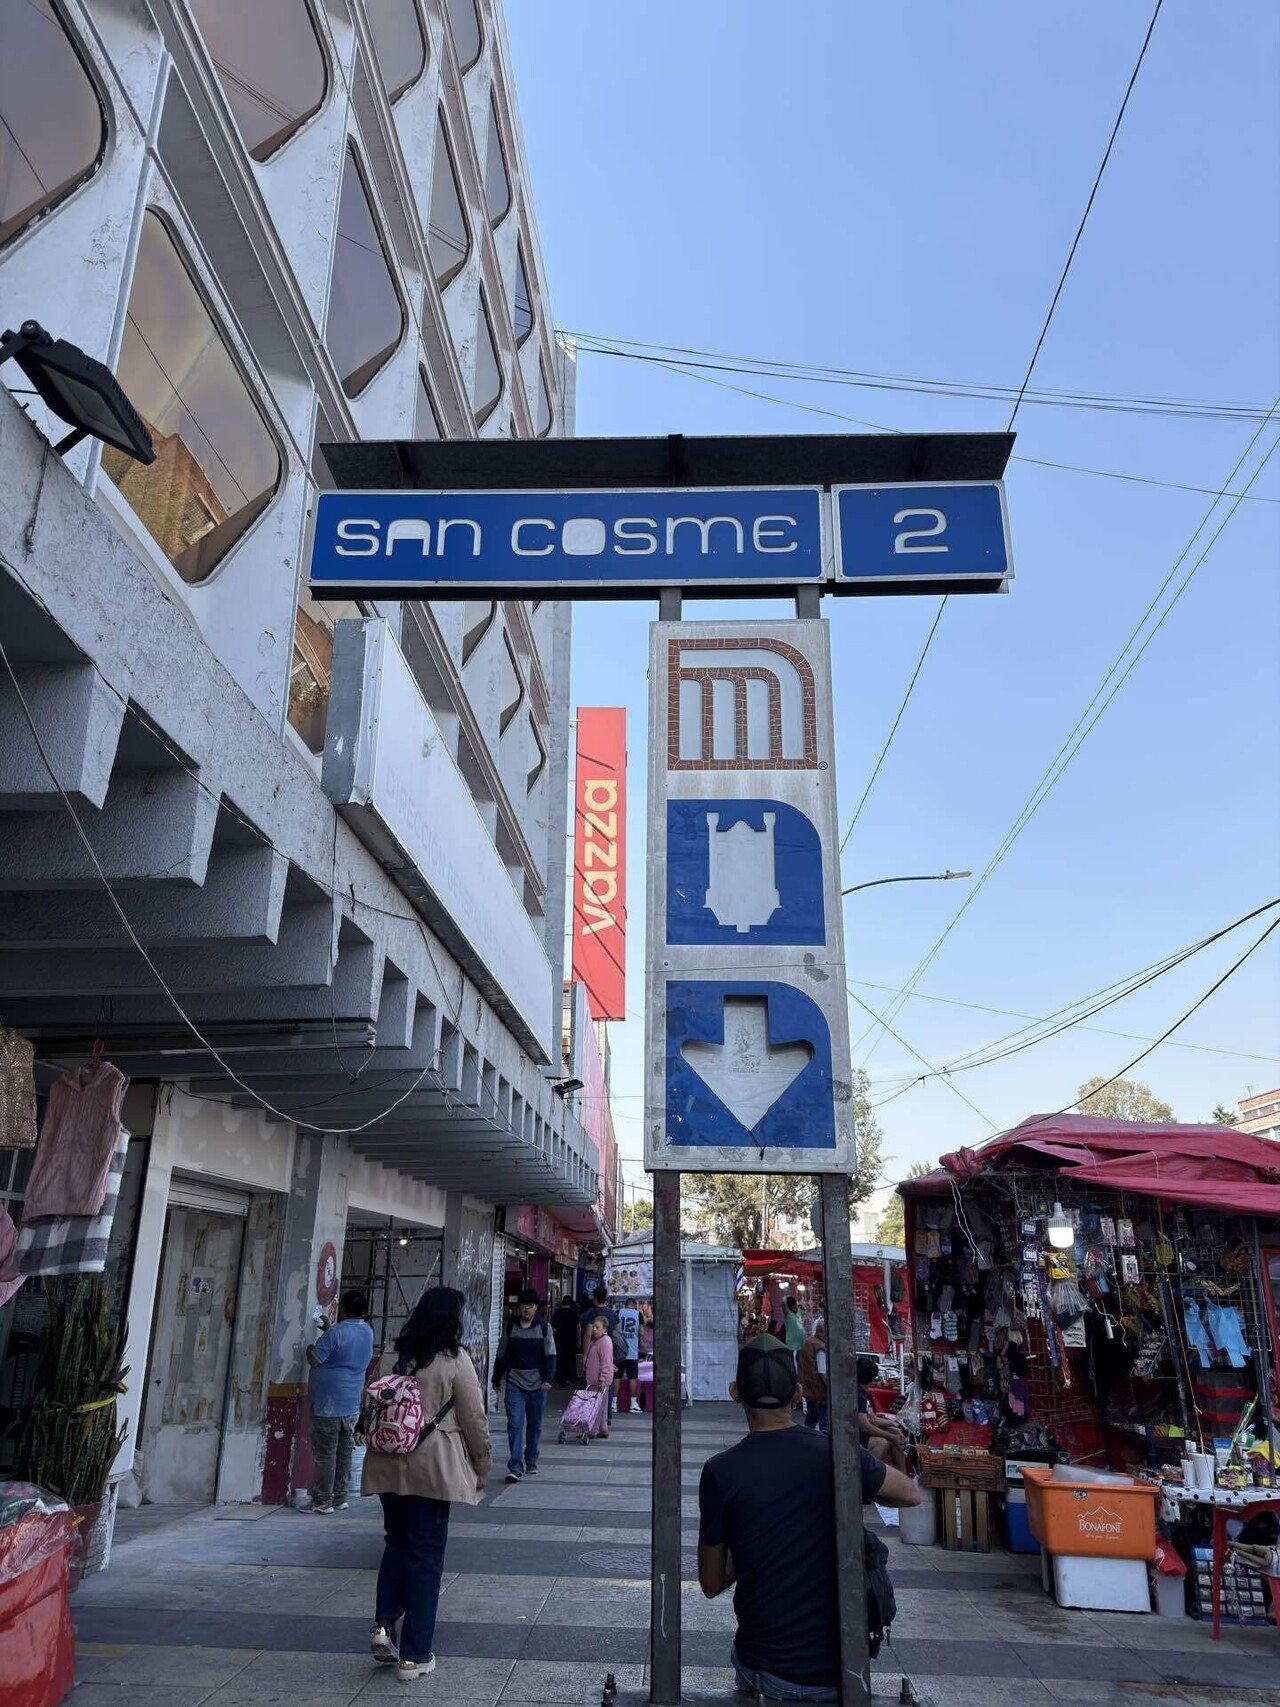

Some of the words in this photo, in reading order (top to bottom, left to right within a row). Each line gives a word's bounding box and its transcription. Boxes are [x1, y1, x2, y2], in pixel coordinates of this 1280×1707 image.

[335, 519, 482, 556] SAN
[511, 516, 799, 556] COSME
[893, 508, 949, 554] 2
[582, 779, 618, 936] vazza
[621, 1316, 636, 1332] 12
[1078, 1519, 1123, 1534] BONAFONT
